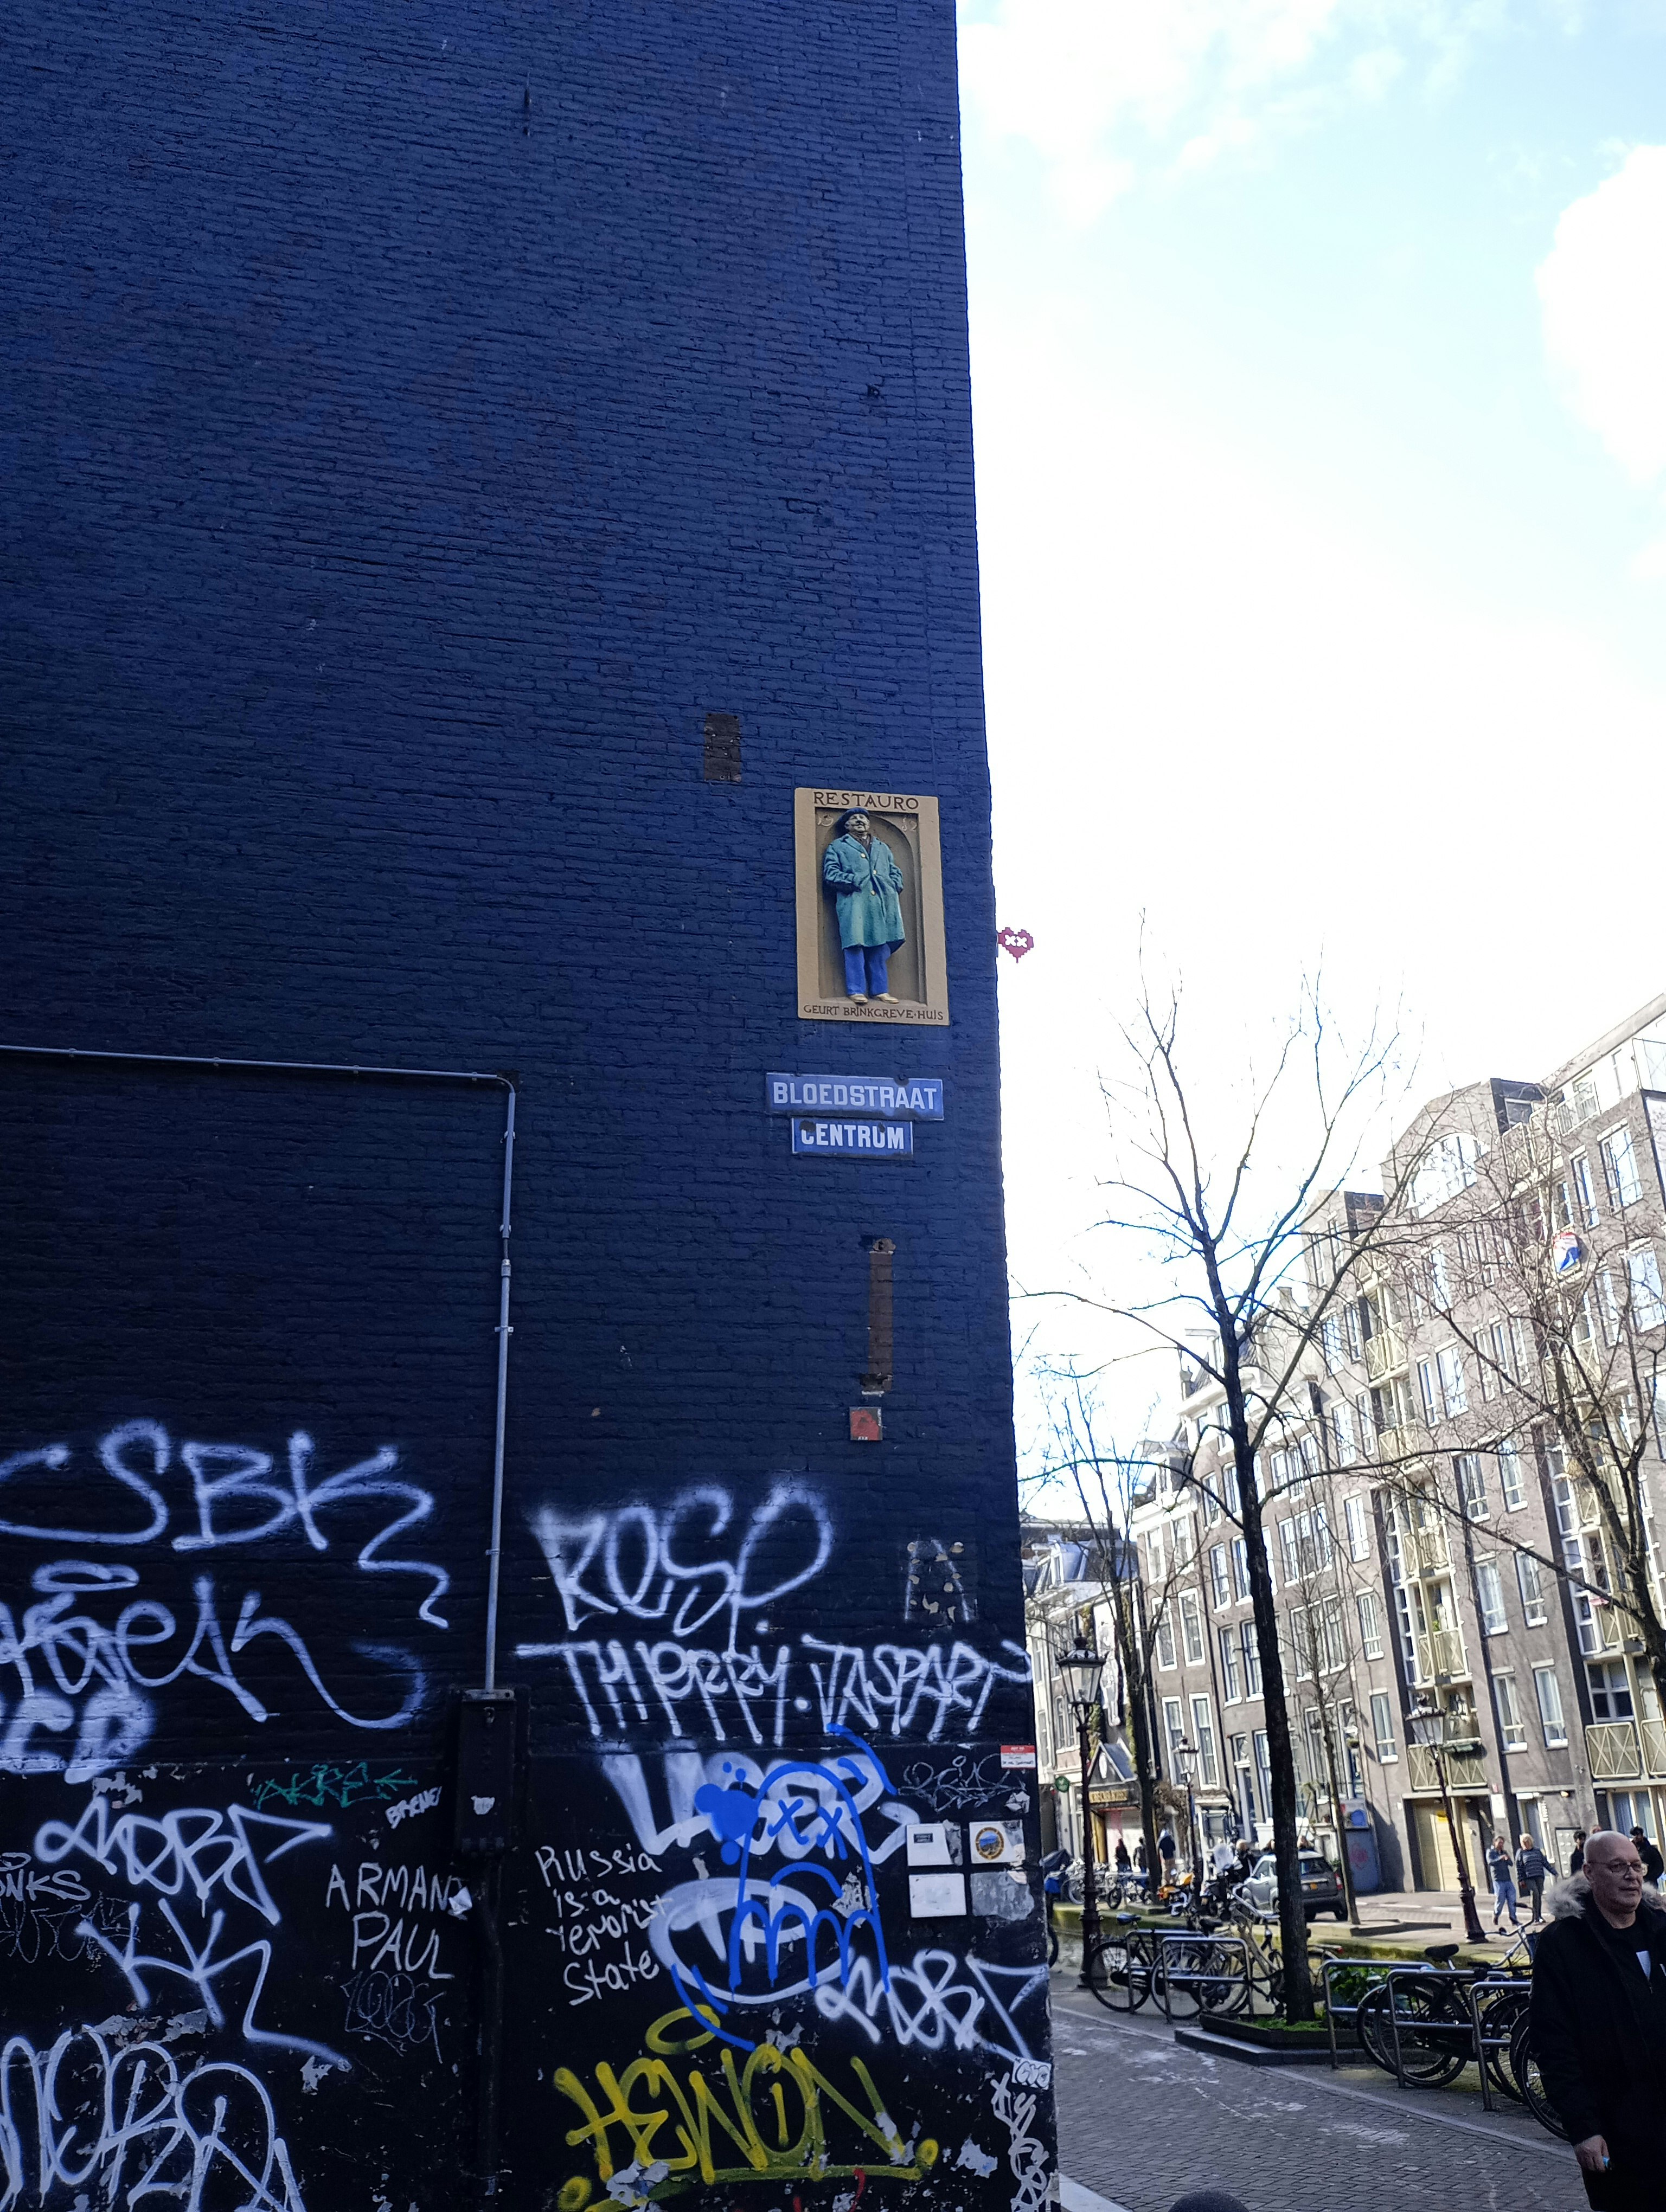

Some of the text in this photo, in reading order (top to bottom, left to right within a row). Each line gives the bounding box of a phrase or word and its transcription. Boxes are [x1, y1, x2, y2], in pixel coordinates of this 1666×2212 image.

[813, 791, 919, 811] RESTAURO
[803, 1005, 840, 1015] GEURT
[773, 1082, 937, 1110] BLOEDSTRAAT
[800, 1123, 904, 1149] CENTRUM
[534, 1843, 663, 1887] Russia
[553, 1888, 585, 1918] is
[352, 1910, 454, 1979] PAUL
